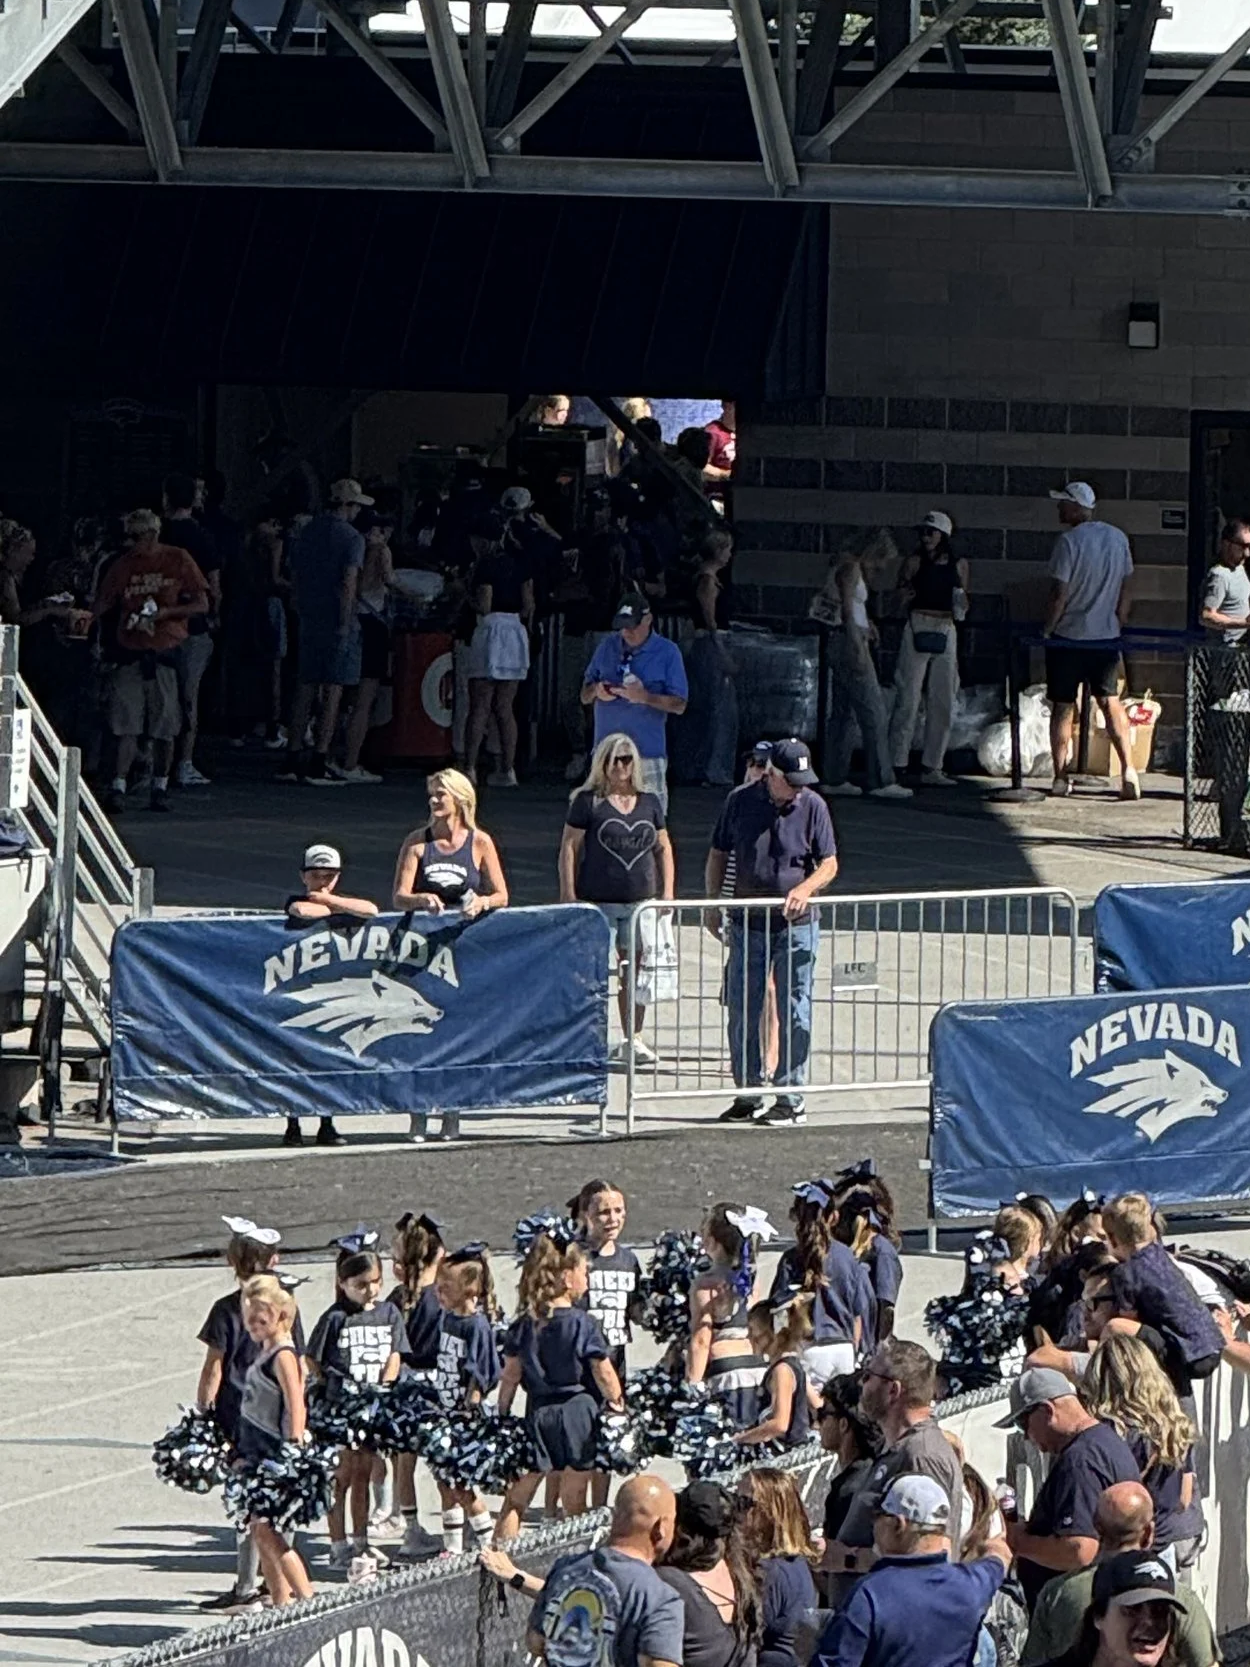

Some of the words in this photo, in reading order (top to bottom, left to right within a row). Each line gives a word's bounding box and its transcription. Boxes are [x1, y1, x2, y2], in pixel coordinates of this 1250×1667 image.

[424, 865, 468, 879] NEVADA
[263, 925, 460, 994] NEVADA
[1070, 1002, 1242, 1078] NEVADA
